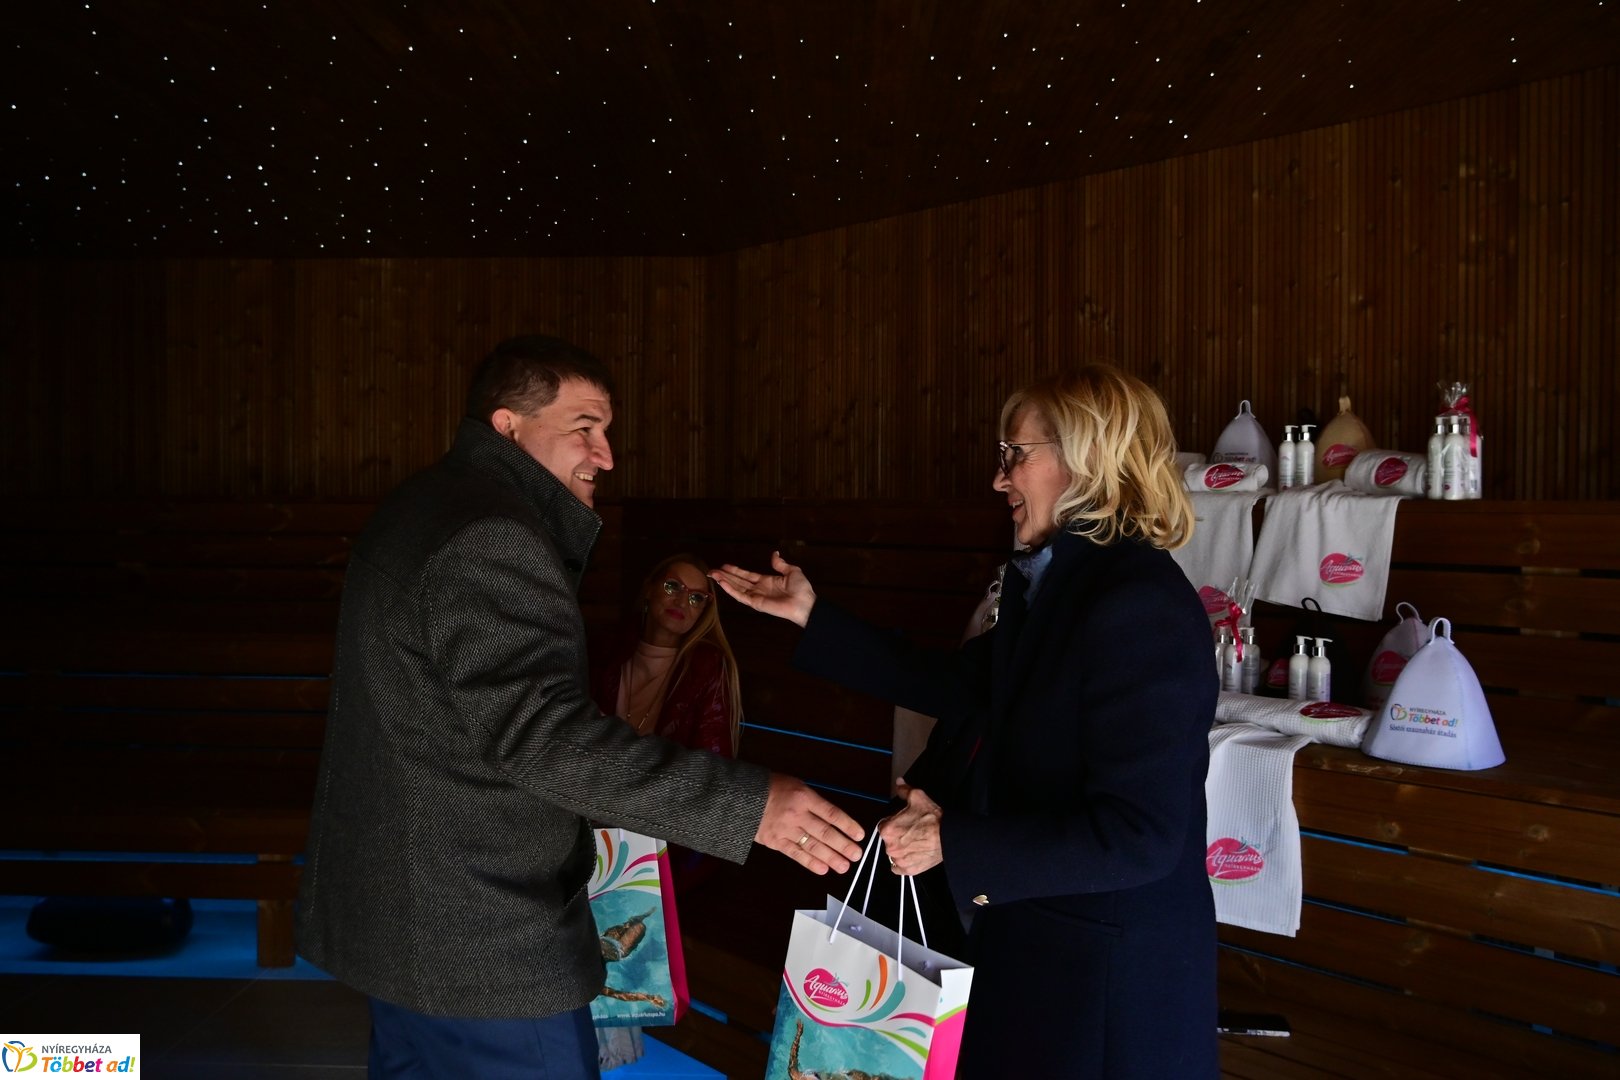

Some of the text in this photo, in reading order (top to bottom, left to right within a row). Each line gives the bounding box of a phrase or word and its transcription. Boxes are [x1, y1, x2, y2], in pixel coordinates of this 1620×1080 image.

[1409, 713, 1459, 728] Többet ad!
[1206, 846, 1264, 877] Aquarius
[804, 974, 848, 999] Aquarius
